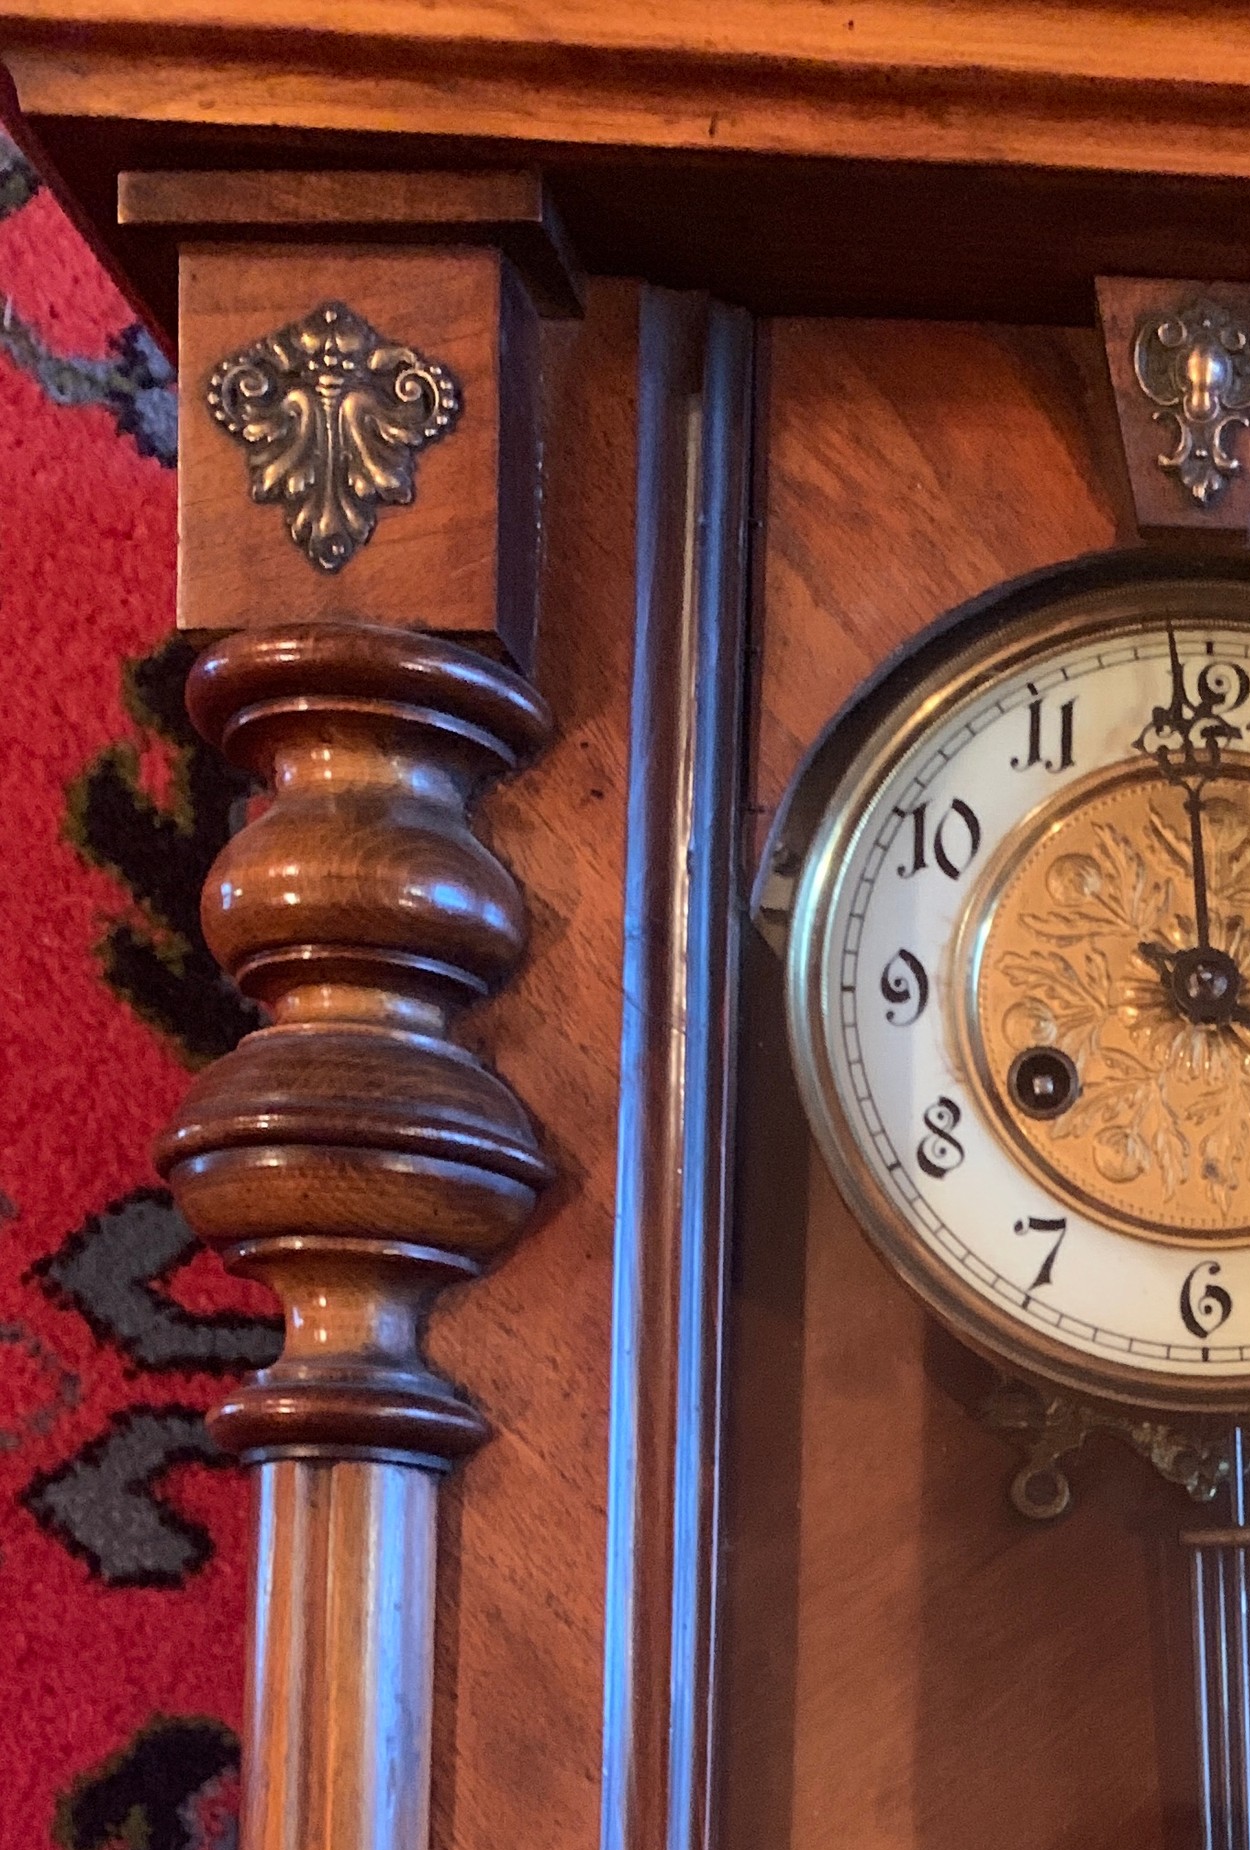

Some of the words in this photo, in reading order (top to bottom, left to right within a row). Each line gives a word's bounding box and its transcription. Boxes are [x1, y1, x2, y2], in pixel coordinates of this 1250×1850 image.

[1010, 697, 1079, 773] 11
[897, 799, 981, 881] 10
[880, 949, 928, 1026] 9
[916, 1096, 965, 1179] 8
[1014, 1216, 1067, 1292] 7
[1180, 1260, 1233, 1339] 6
